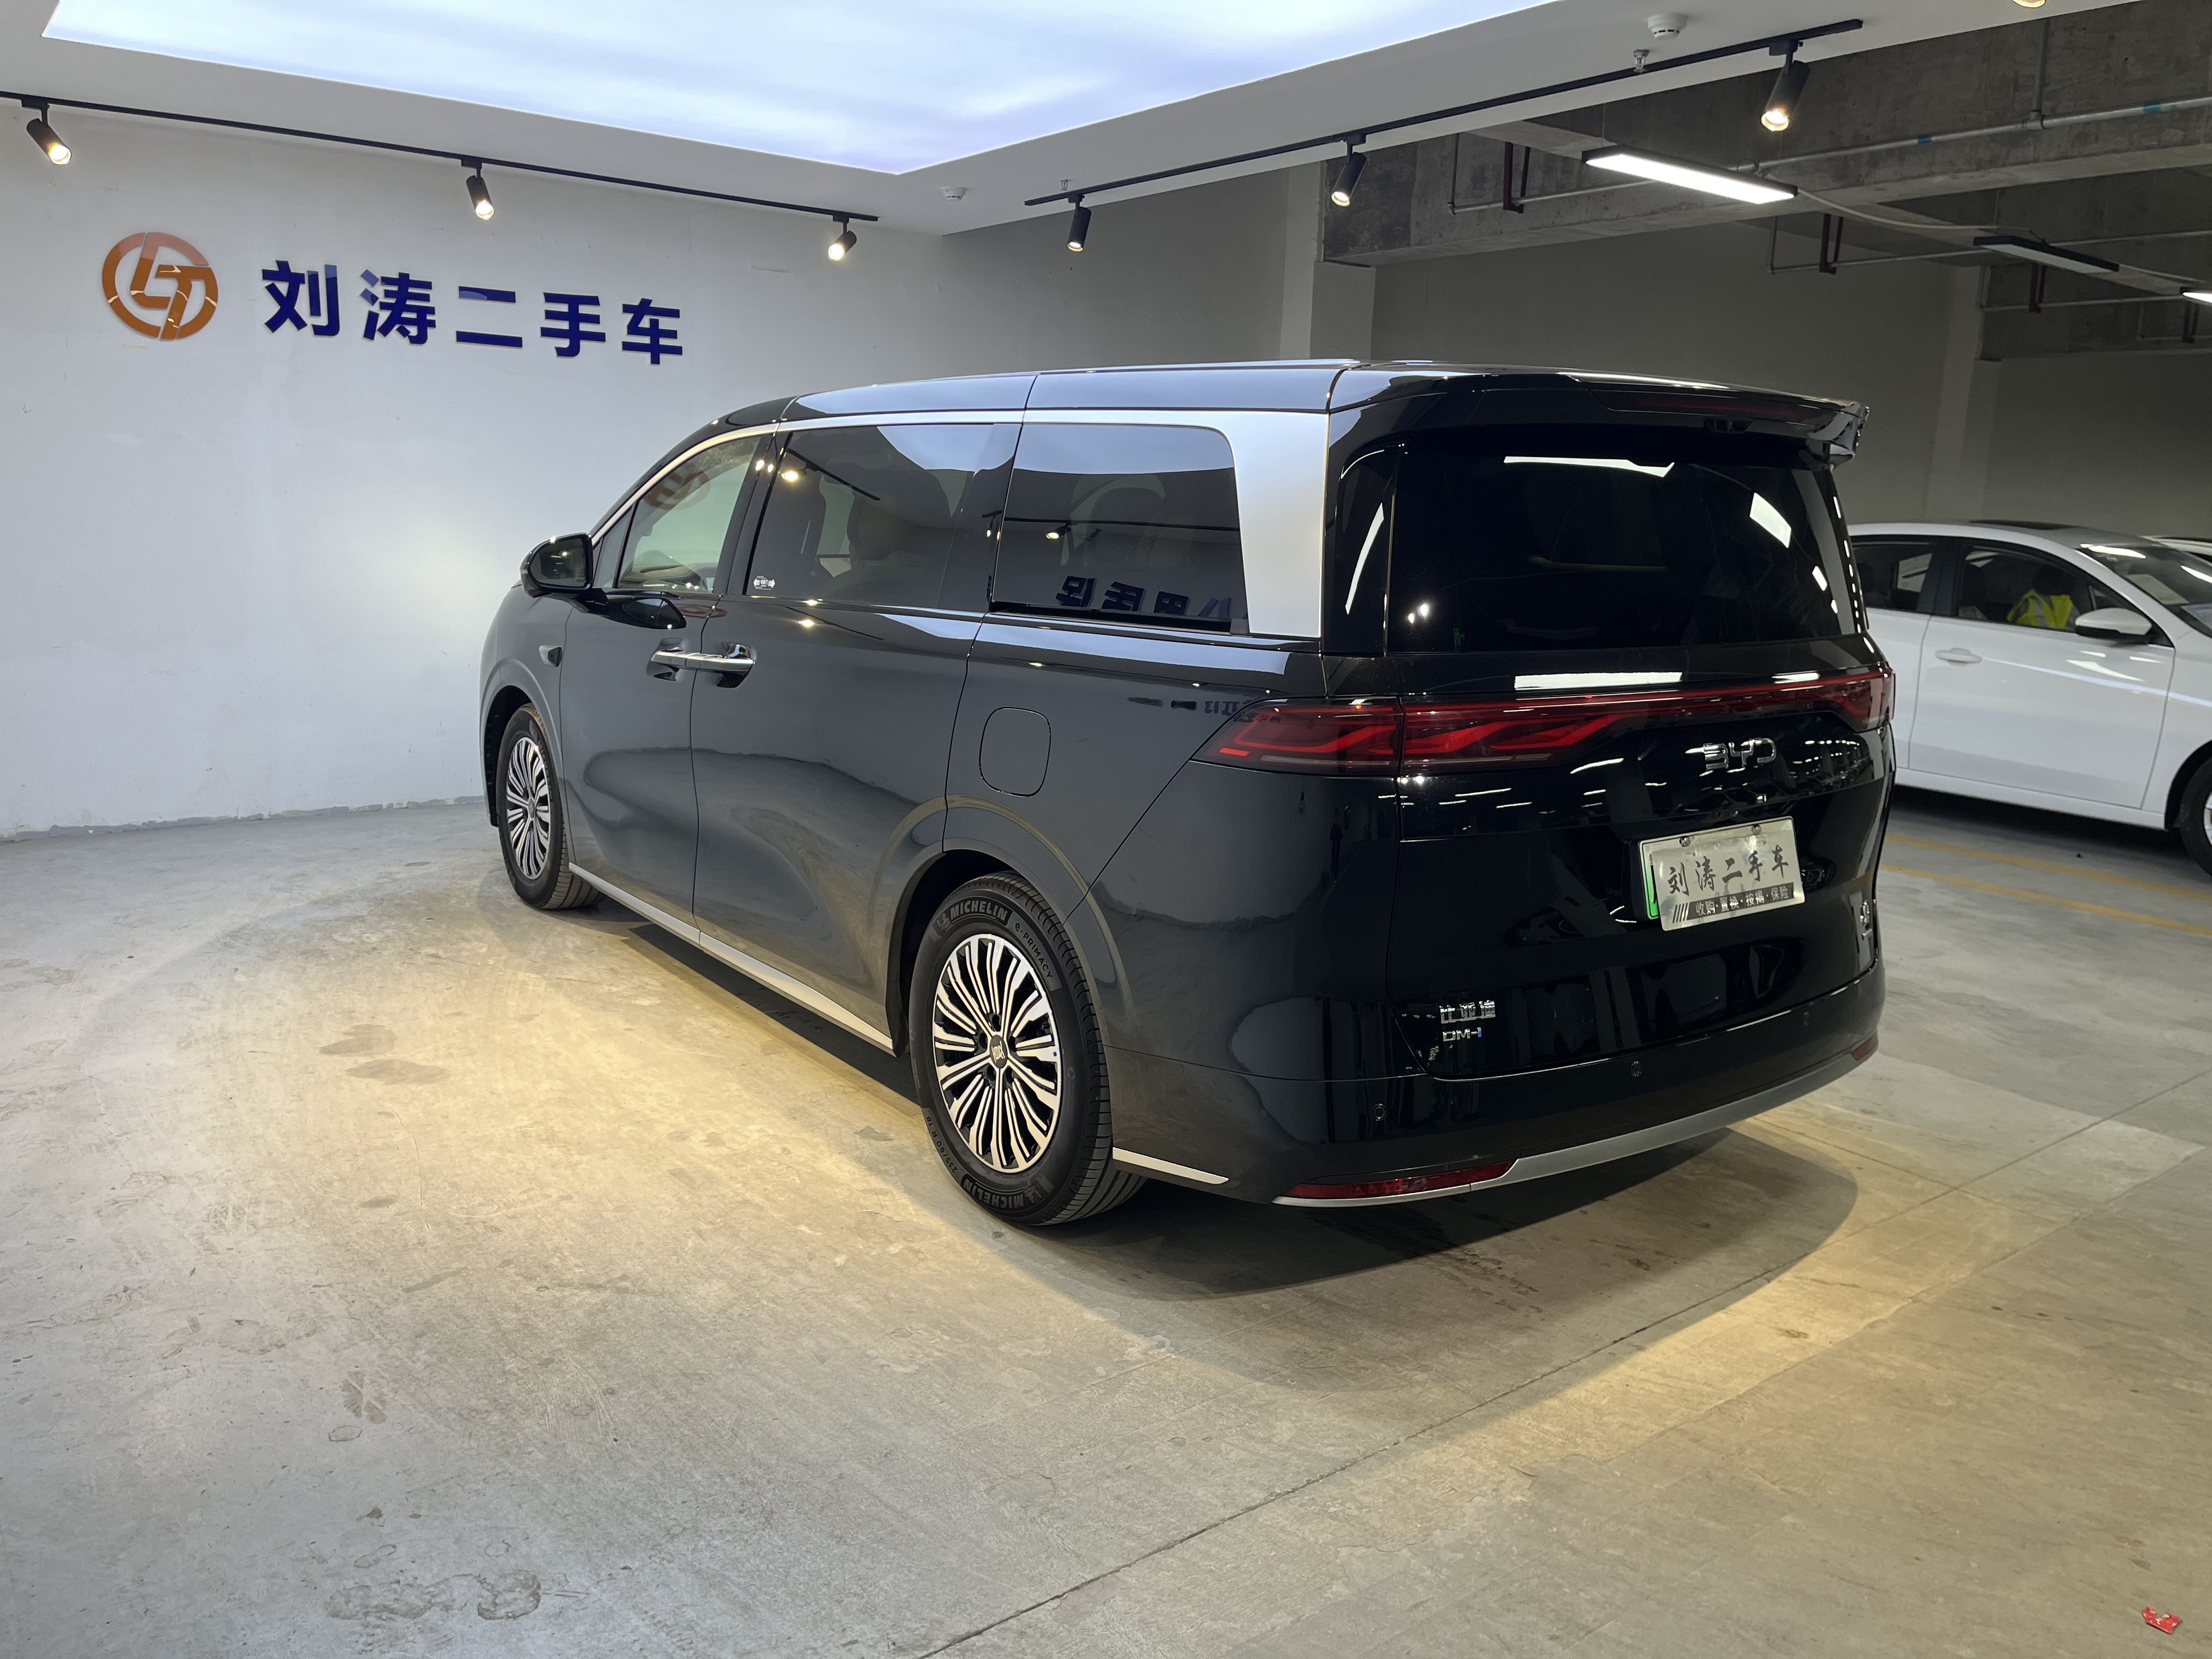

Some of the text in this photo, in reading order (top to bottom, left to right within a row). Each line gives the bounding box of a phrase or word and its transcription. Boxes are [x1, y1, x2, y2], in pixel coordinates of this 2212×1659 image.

[261, 259, 683, 365] 刘涛二手车
[1703, 737, 1777, 770] BYD
[1667, 844, 1790, 896] 刘涛二手车
[950, 899, 1008, 921] MICHELIN
[1439, 999, 1496, 1024] 比亚迪
[926, 1116, 933, 1127] 18
[936, 1141, 958, 1174] 235/60
[962, 1178, 1024, 1209] MICHELIN
